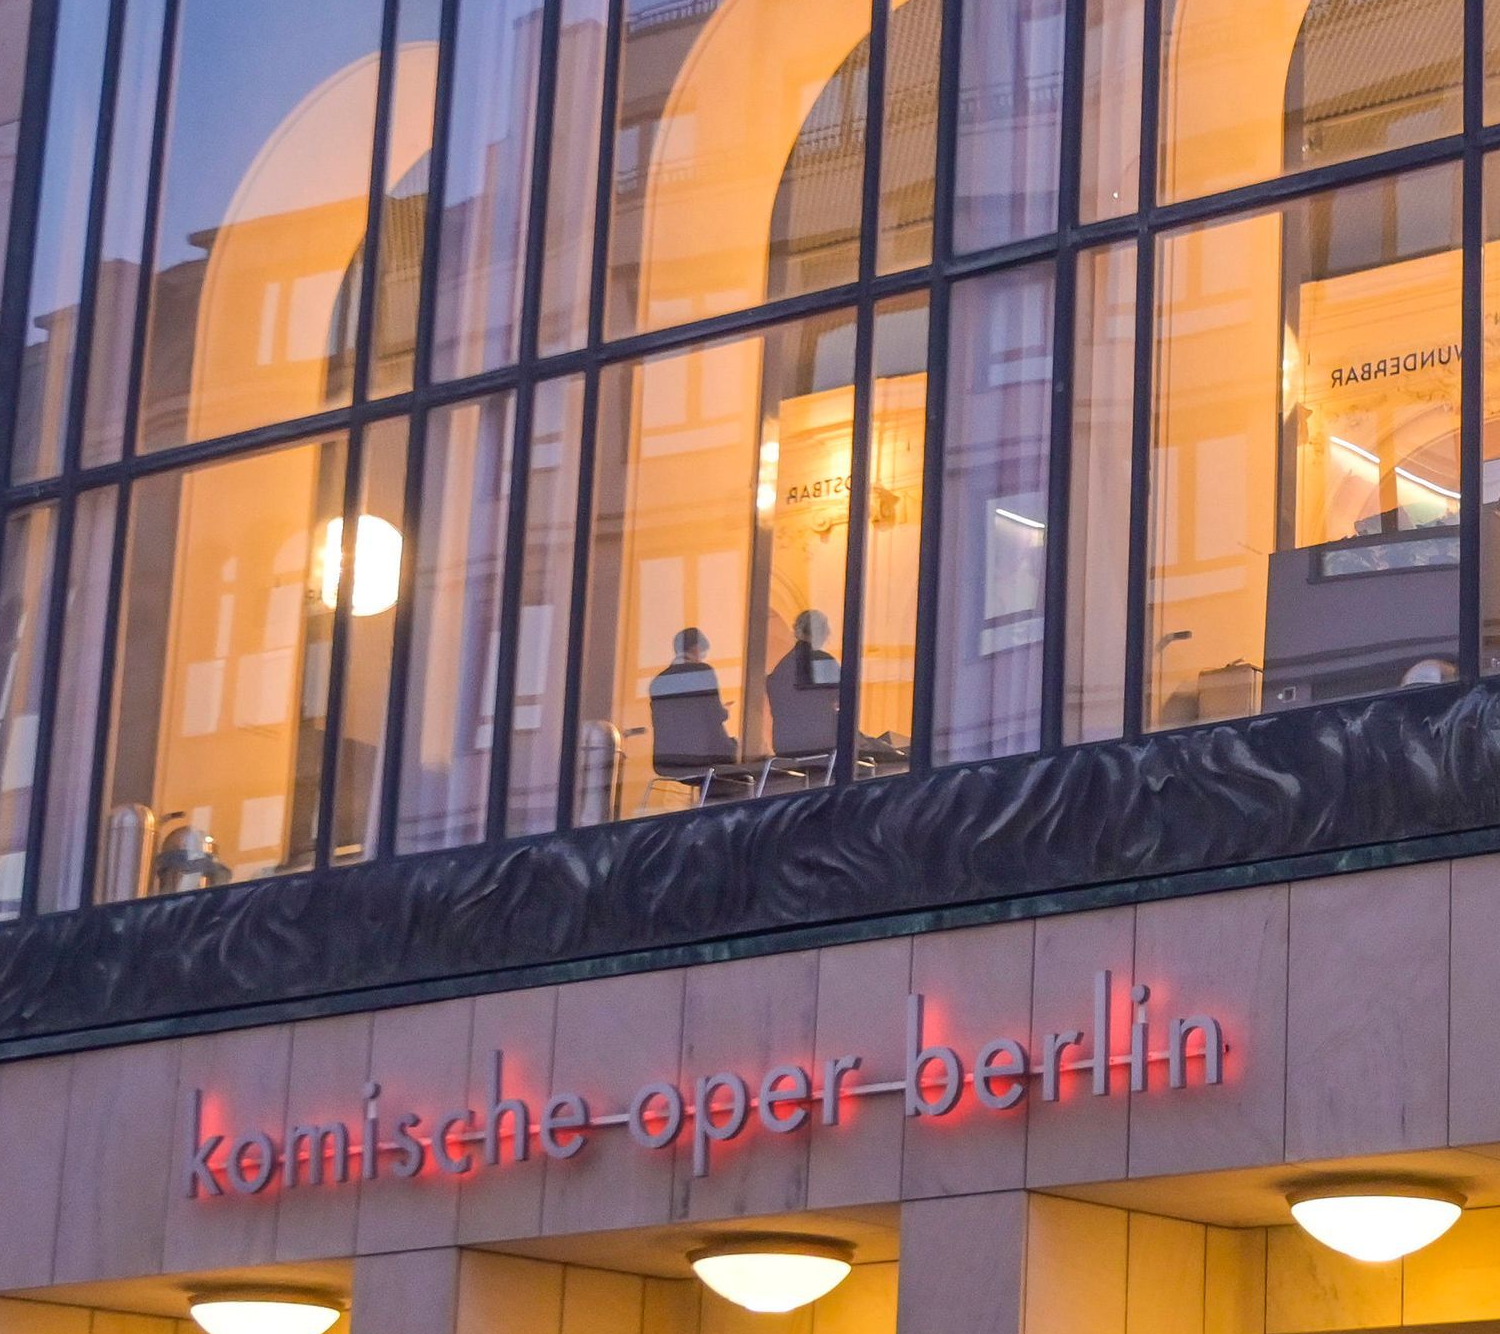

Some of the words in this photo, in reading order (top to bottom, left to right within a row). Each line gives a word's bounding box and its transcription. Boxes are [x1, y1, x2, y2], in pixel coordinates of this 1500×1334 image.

[184, 1049, 589, 1200] komische
[627, 1053, 864, 1179] oper
[903, 969, 1225, 1120] berlin
